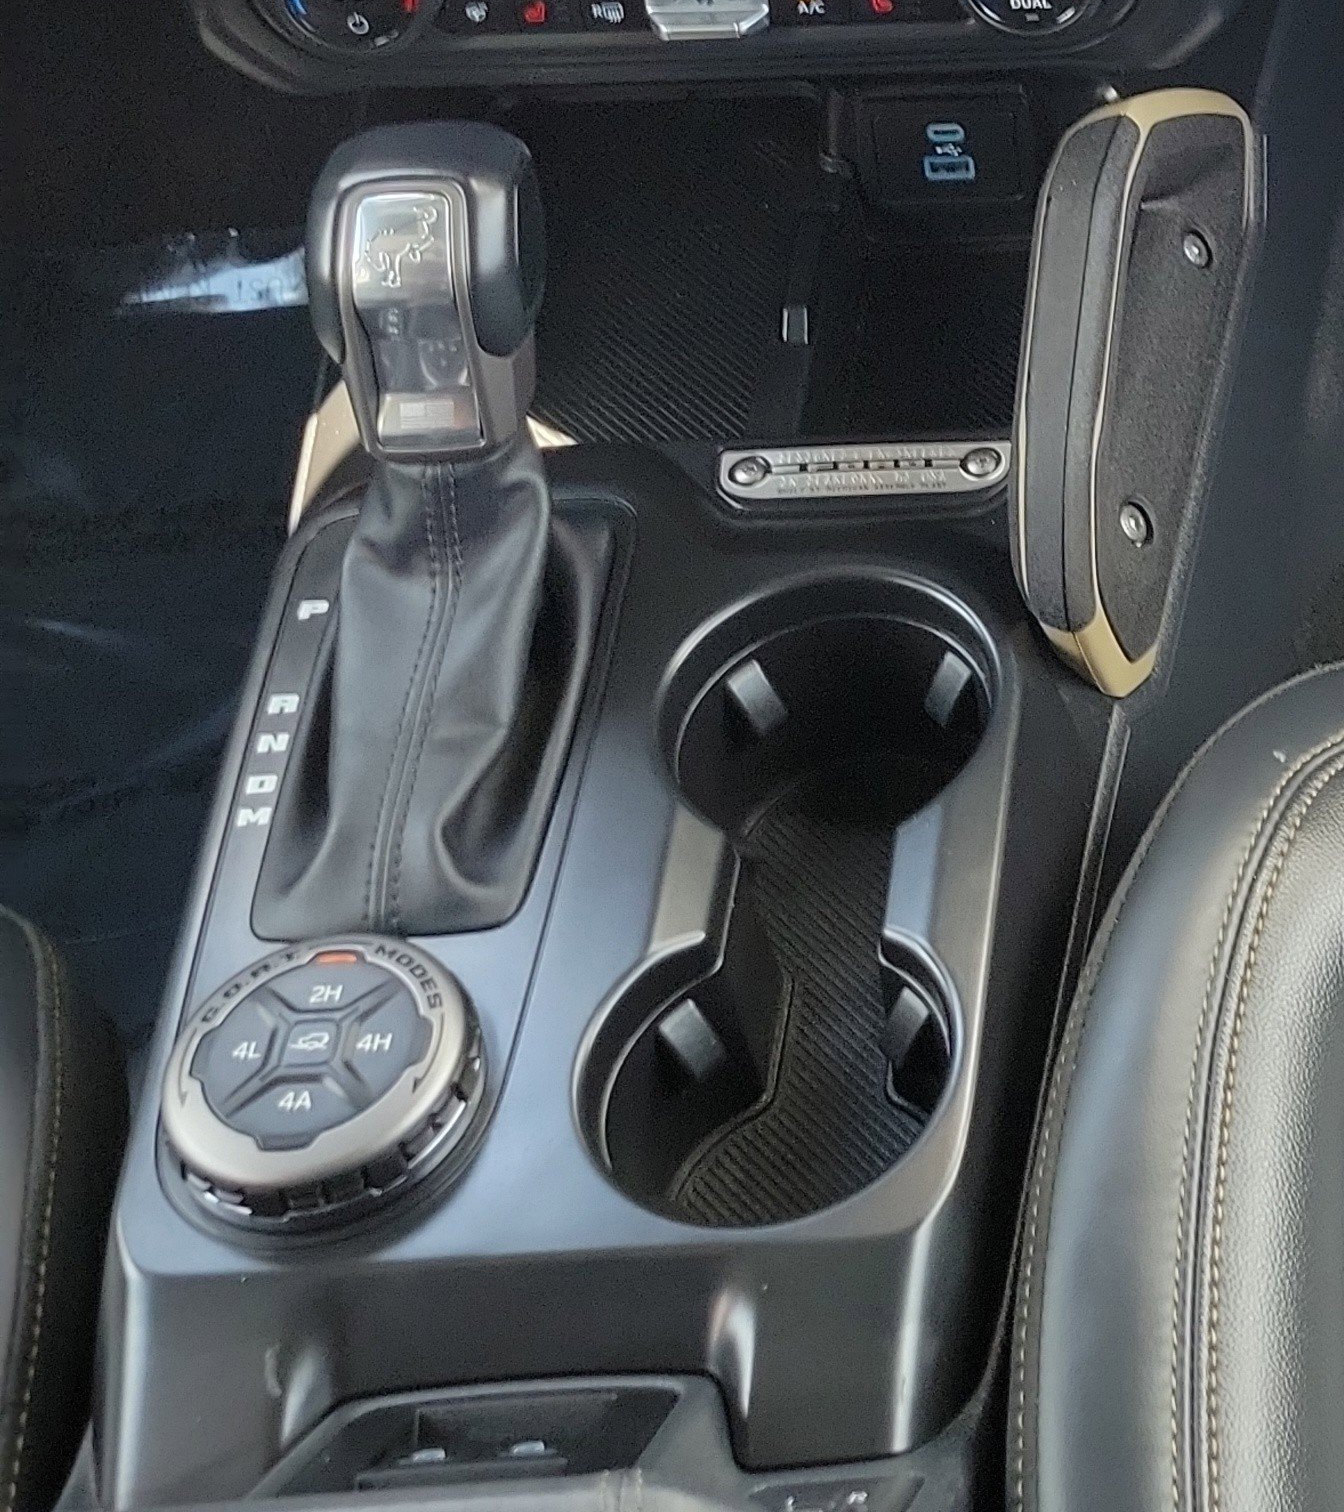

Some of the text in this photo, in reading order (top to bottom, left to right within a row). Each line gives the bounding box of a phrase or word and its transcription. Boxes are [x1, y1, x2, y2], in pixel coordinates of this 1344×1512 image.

[797, 0, 827, 15] A/C
[297, 599, 330, 620] P
[256, 732, 290, 754] N
[245, 774, 278, 796] D
[236, 807, 272, 828] M
[373, 943, 443, 1011] MODES
[309, 984, 344, 1005] 2H
[231, 1041, 263, 1061] 4L
[356, 1032, 393, 1053] 4H
[278, 1090, 313, 1111] 4A
